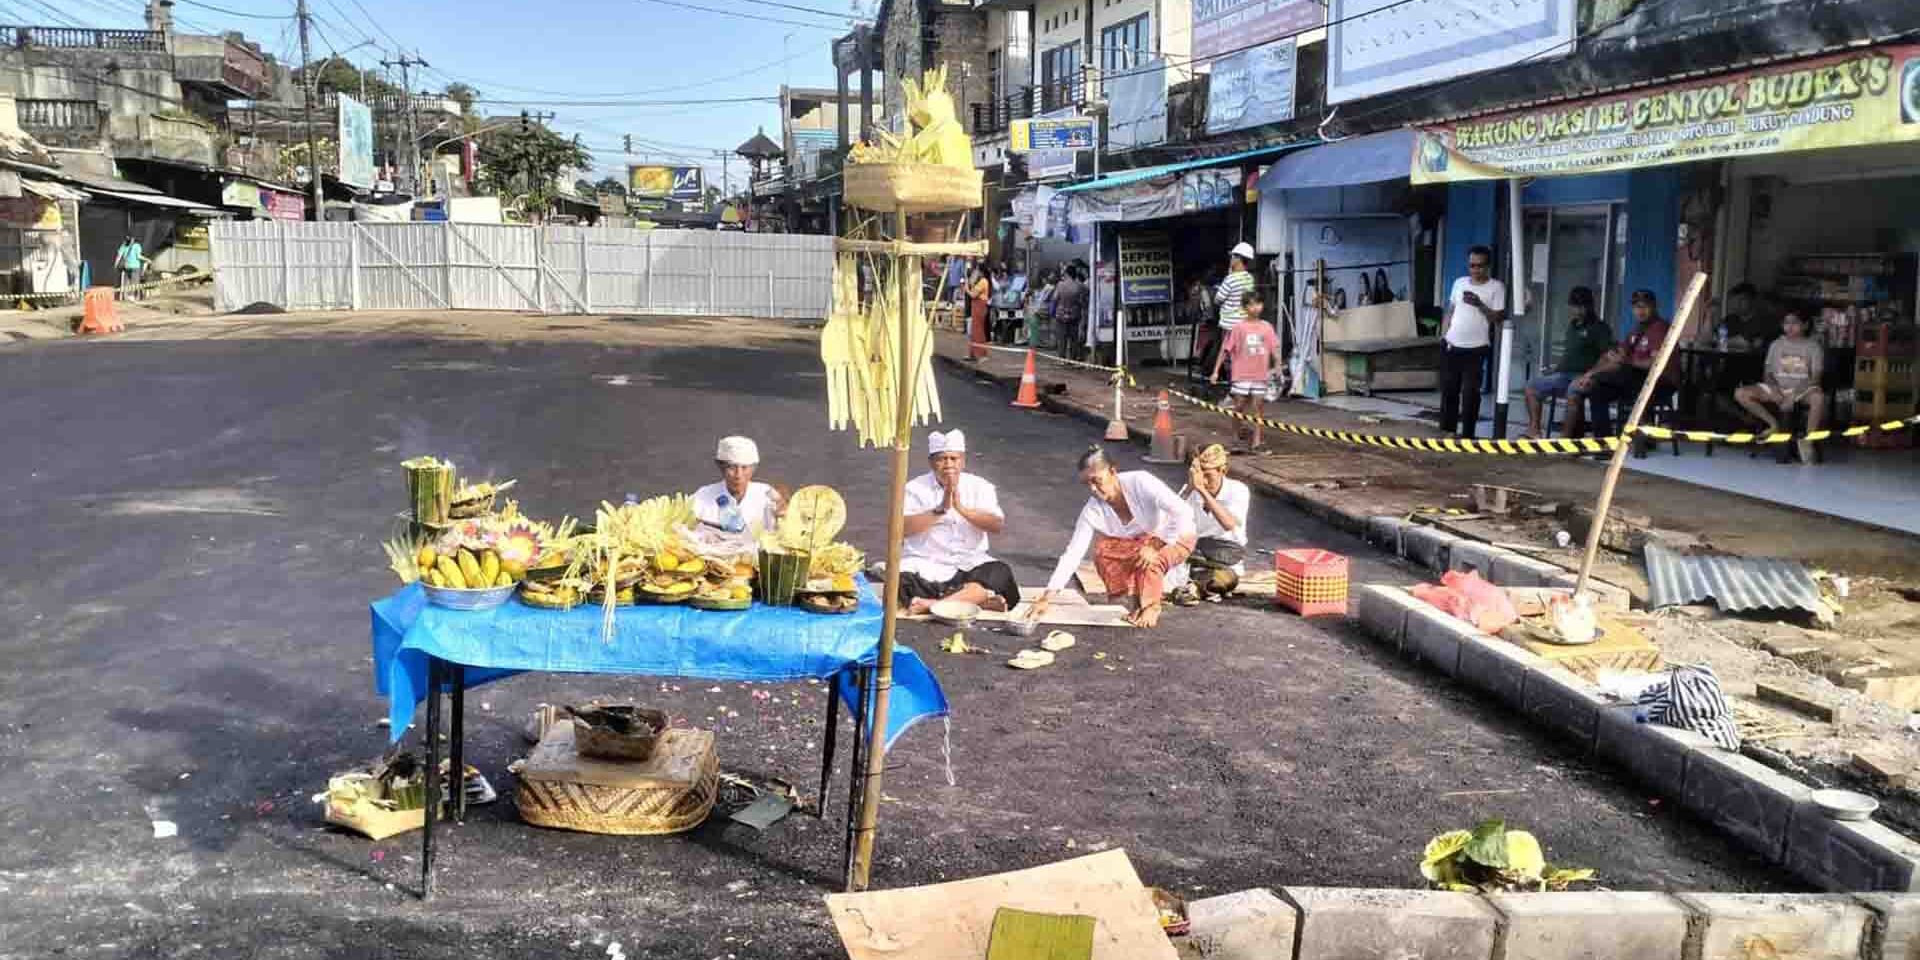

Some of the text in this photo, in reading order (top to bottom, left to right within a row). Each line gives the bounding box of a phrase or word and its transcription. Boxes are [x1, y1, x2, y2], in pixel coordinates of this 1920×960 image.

[1456, 115, 1537, 147] WARUNG
[1539, 106, 1594, 138] NASI
[1598, 101, 1629, 131] BE
[1121, 251, 1169, 263] SEPEDA
[1122, 264, 1170, 277] MOTOR
